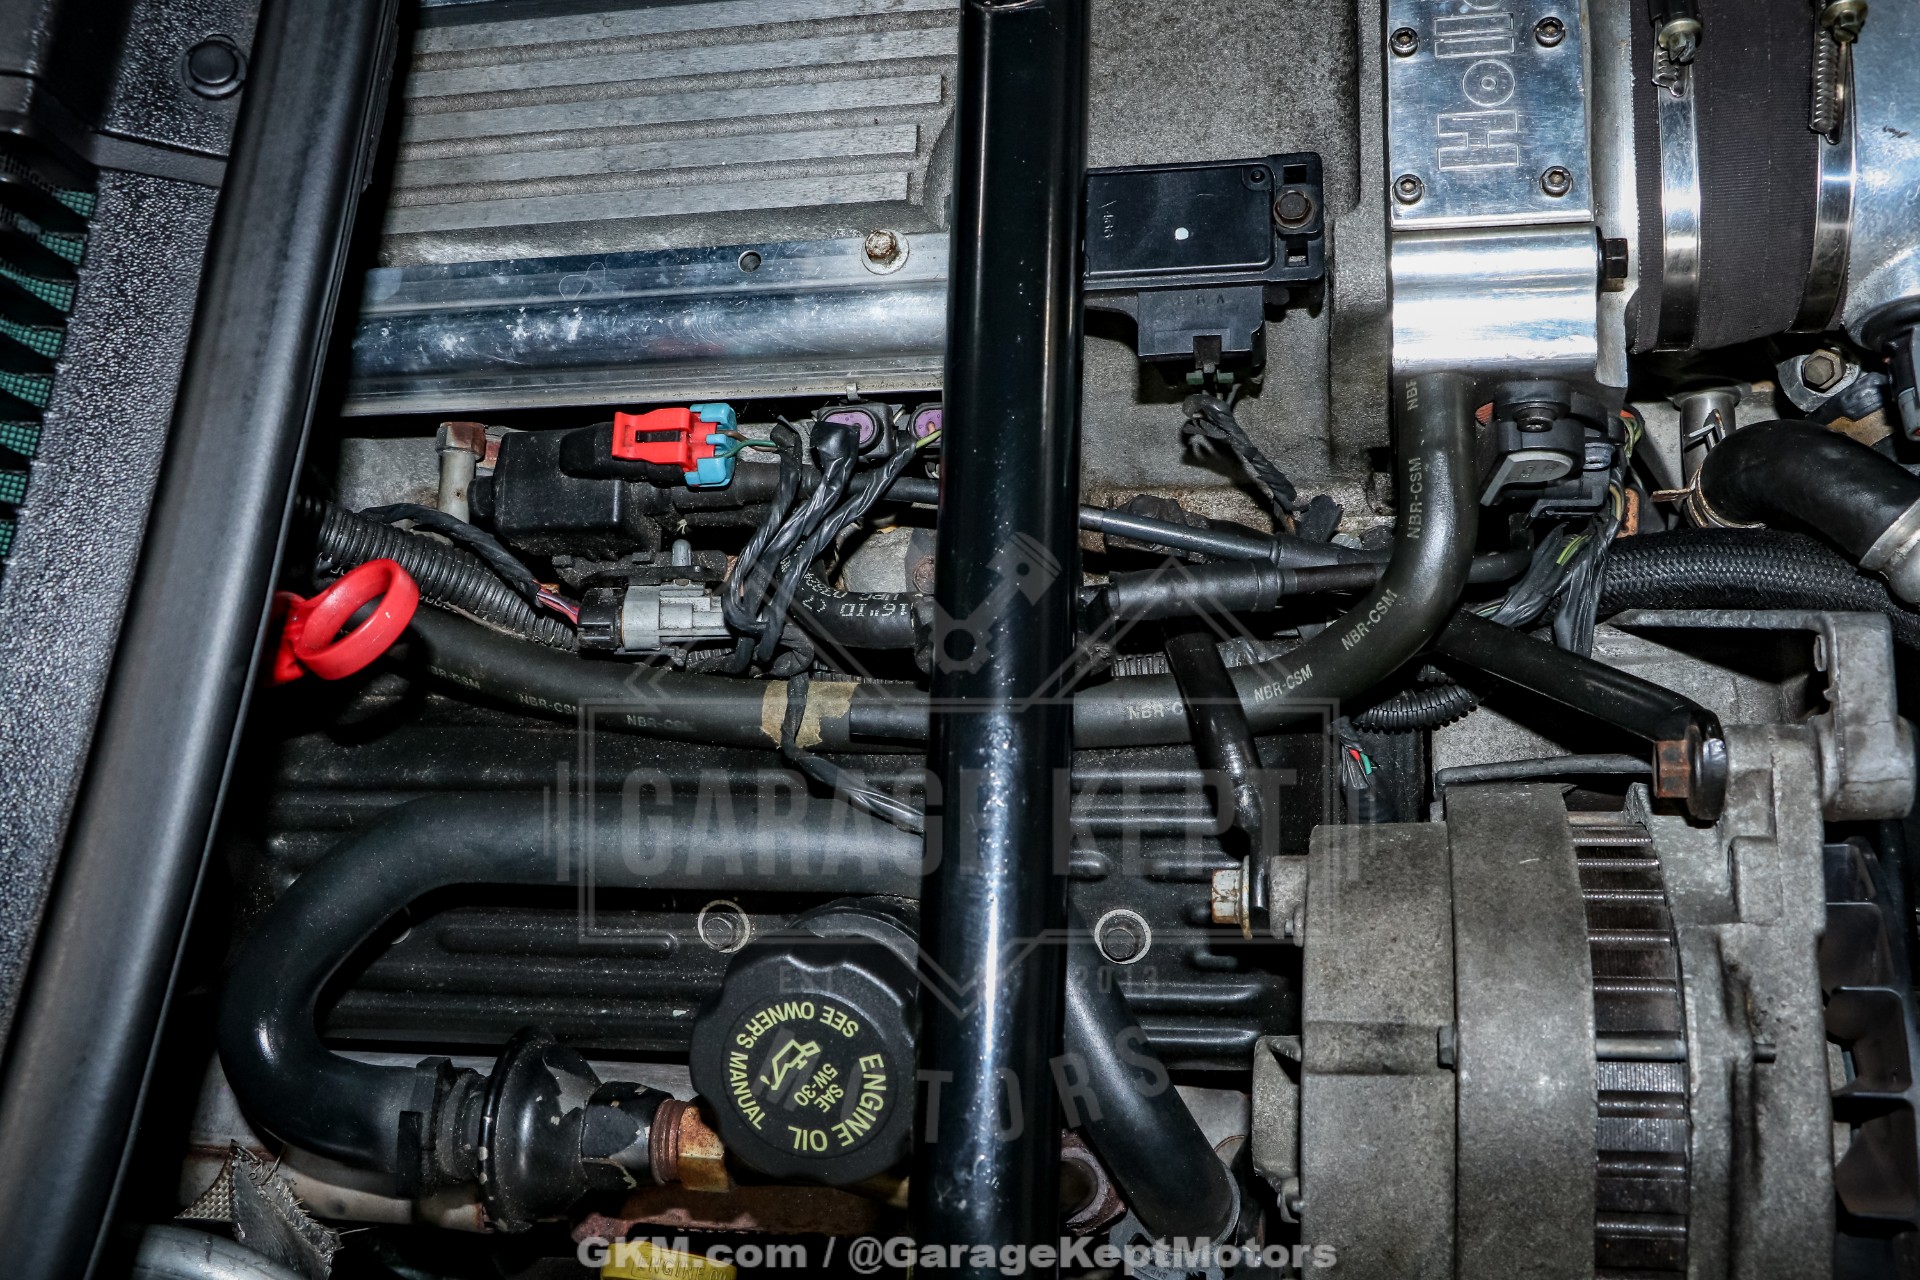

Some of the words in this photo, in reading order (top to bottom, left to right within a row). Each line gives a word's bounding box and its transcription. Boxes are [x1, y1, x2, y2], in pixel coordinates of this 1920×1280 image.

[1433, 0, 1520, 171] Holl
[1406, 456, 1423, 539] NBR-CSM
[1340, 588, 1399, 651] NBR-CSM
[426, 663, 482, 690] BR-CSM
[1253, 663, 1314, 703] NBR-CSM
[518, 692, 584, 715] NBR-CSM
[736, 1001, 815, 1049] OWNER'S
[819, 1005, 859, 1038] SEE
[729, 1051, 766, 1131] MANUAL
[793, 1063, 839, 1107] 5W-30
[813, 1084, 844, 1113] SAE
[831, 1054, 887, 1147] ENGINE
[787, 1125, 829, 1152] OIL
